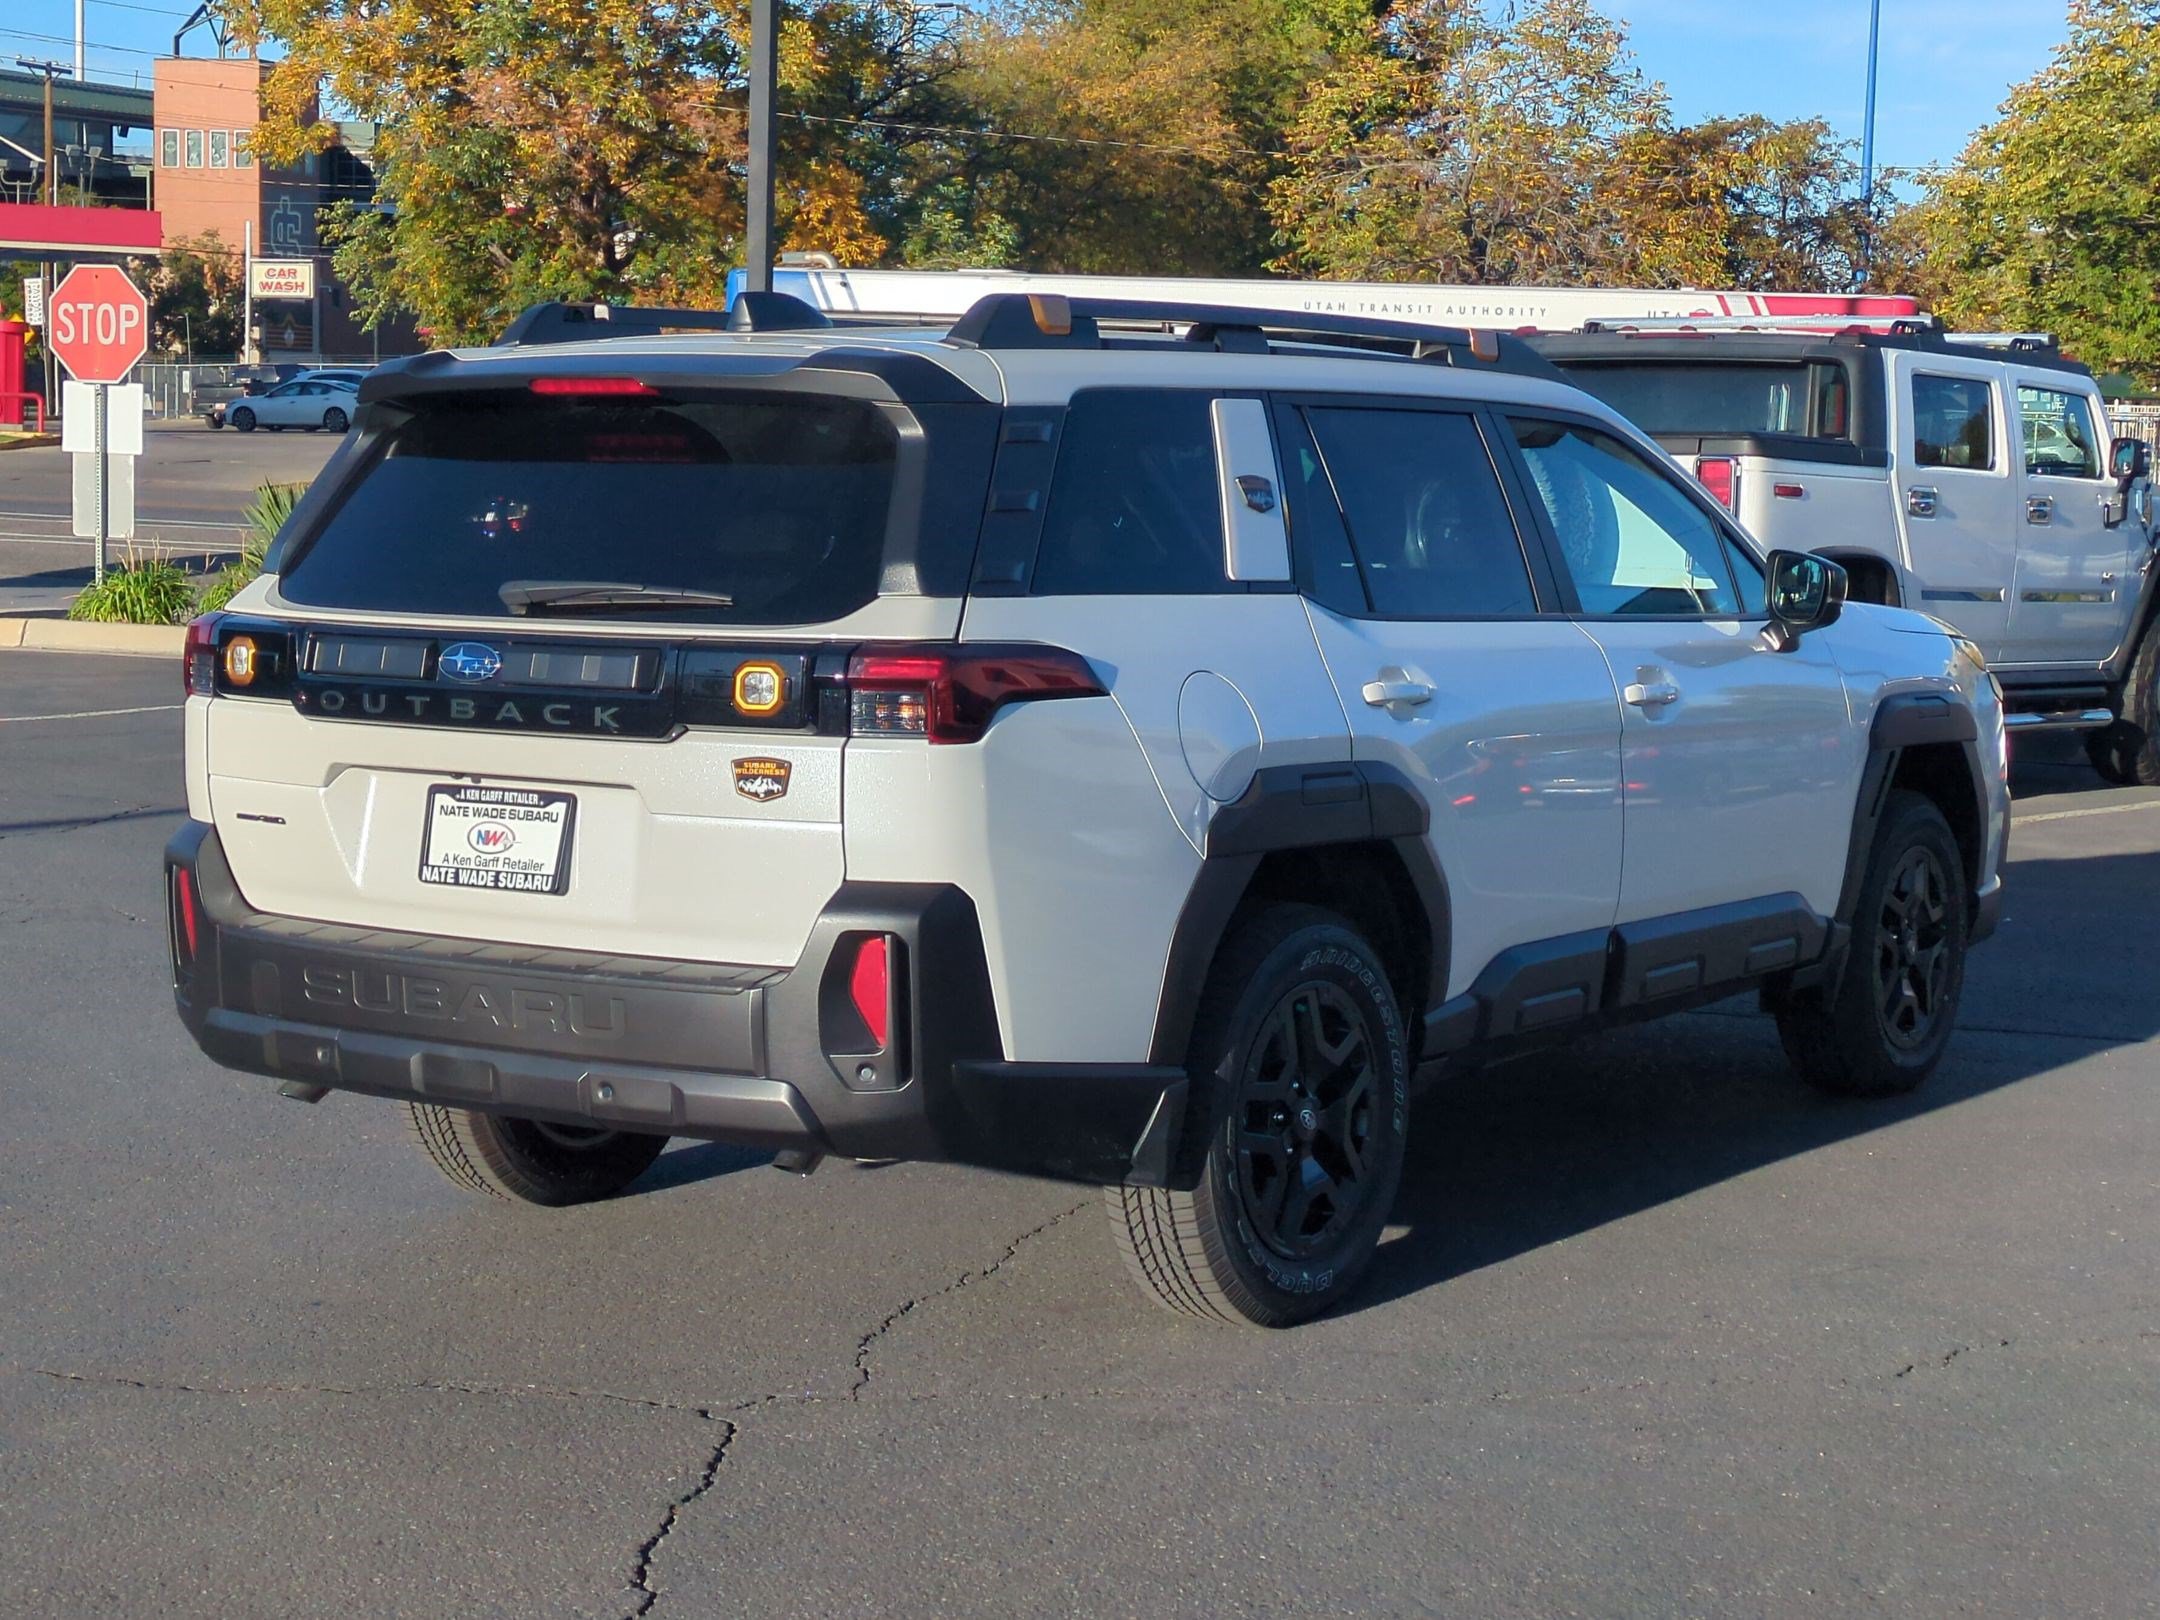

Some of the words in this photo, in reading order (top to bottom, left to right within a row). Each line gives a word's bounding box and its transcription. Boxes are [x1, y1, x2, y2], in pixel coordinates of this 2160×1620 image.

[265, 268, 297, 279] CAR
[259, 281, 305, 292] WASH
[1304, 301, 1346, 312] UTAH
[1359, 303, 1433, 314] TRANSIT
[1446, 306, 1547, 317] AUTHORITY
[56, 302, 140, 346] STOP
[319, 689, 620, 729] OUTBACK
[735, 768, 786, 776] WILDERNESS
[460, 789, 465, 799] A
[466, 789, 480, 800] KEN
[481, 790, 503, 802] GARFF
[504, 791, 538, 805] RETAILER
[439, 805, 469, 817] NATE
[472, 807, 506, 819] WADE
[508, 809, 559, 823] SUBARU
[442, 853, 450, 864] A
[452, 854, 471, 866] Ken
[474, 855, 500, 868] Garff
[502, 857, 544, 872] Retailer
[422, 866, 455, 883] NATE
[458, 868, 496, 886] WADE
[499, 872, 553, 891] SUBARU
[303, 967, 627, 1040] SUBARU
